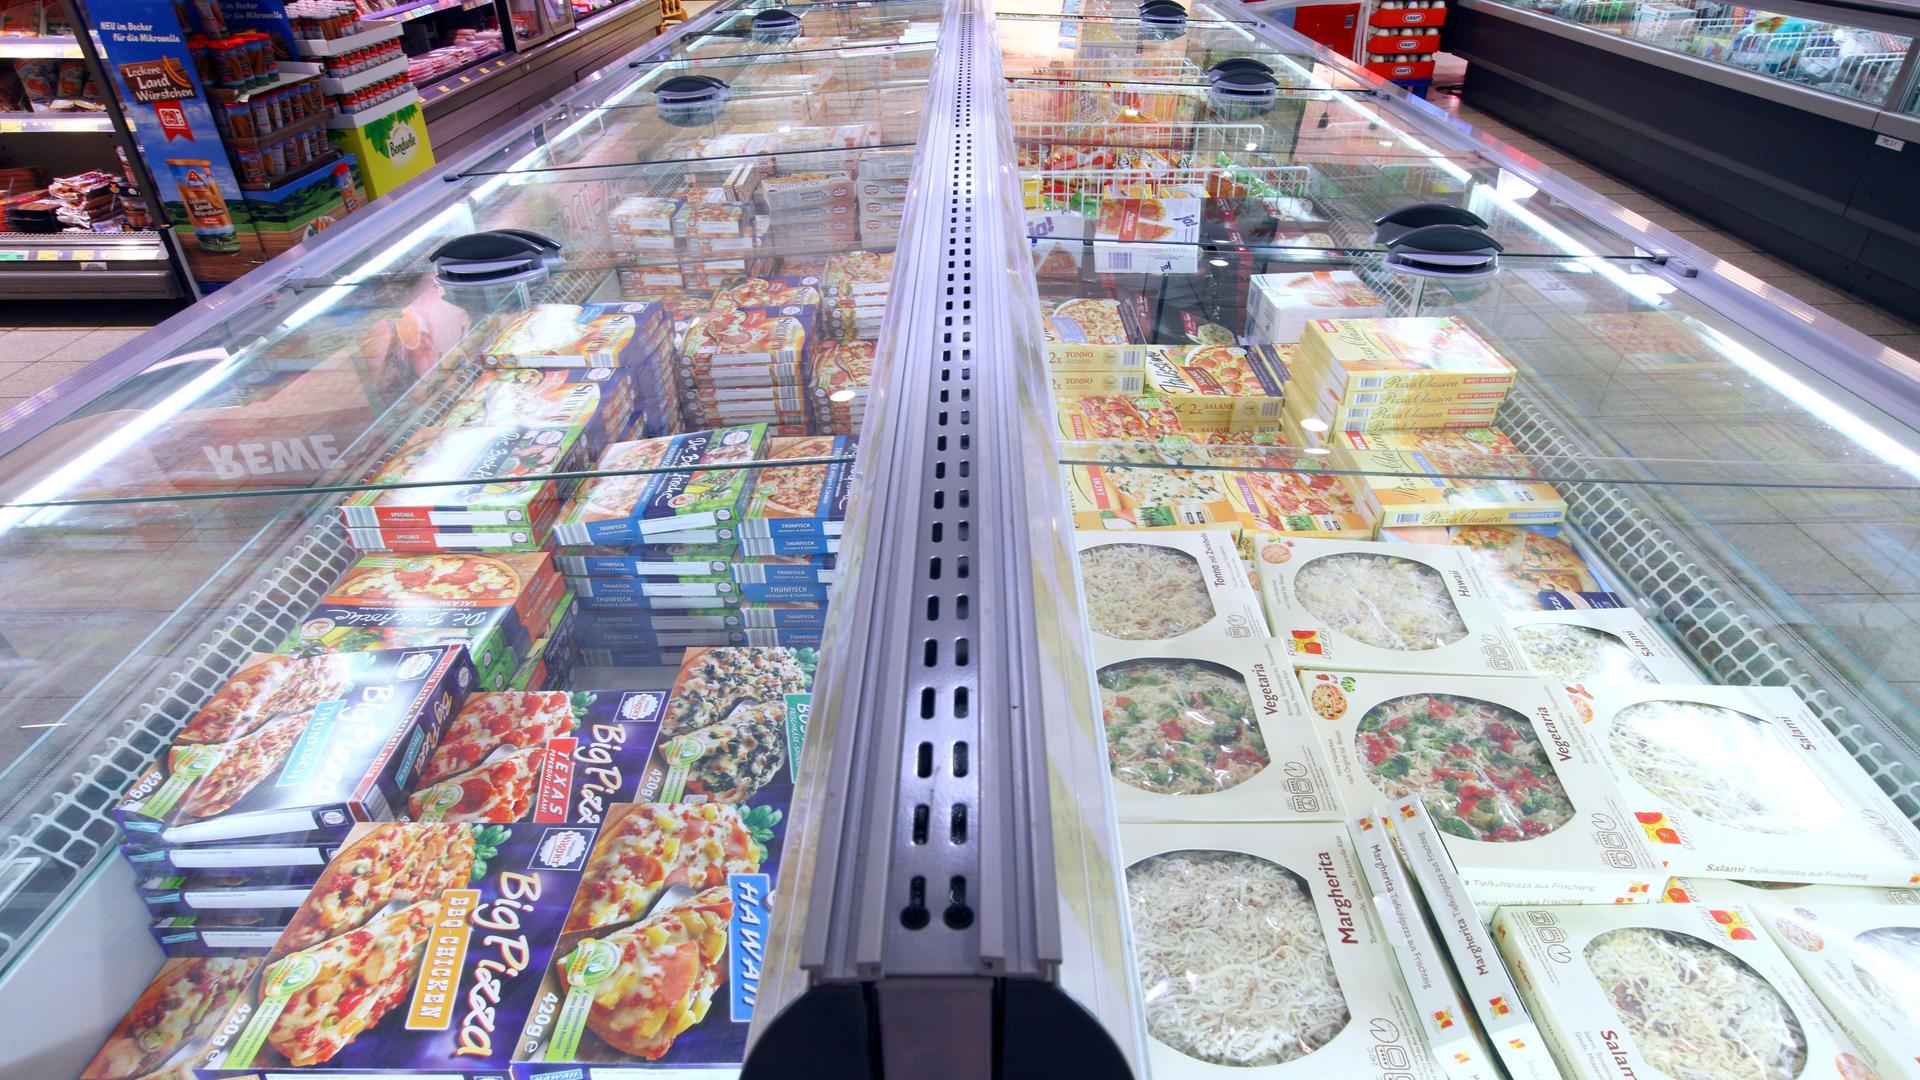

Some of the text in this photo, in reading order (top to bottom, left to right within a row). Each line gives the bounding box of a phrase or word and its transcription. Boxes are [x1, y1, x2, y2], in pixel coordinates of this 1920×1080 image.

[100, 22, 153, 31] NEU im Becher
[112, 34, 181, 43] für die Mikrowelle
[126, 66, 162, 78] Leckere
[137, 75, 171, 89] Land
[136, 89, 194, 102] Würstchen
[389, 134, 416, 157] Bonduelle
[1027, 217, 1055, 239] ja!
[1173, 214, 1198, 228] ja!
[1048, 351, 1094, 364] 2x TONNO
[1065, 377, 1094, 385] TONNO
[1384, 375, 1418, 390] Pizza
[1419, 375, 1458, 389] Classica
[1189, 402, 1202, 415] 2x
[1380, 391, 1411, 406] Pizza
[1371, 405, 1402, 420] Pizza
[688, 437, 707, 453] Die
[599, 524, 627, 532] THUNFISCH
[1422, 510, 1458, 525] Pizza
[1459, 510, 1504, 523] Classica
[1211, 565, 1226, 588] Tonno
[1447, 569, 1472, 598] Hawaii
[459, 611, 488, 626] Die
[1623, 630, 1654, 658] Salami
[1252, 663, 1278, 716] Vegetaria
[434, 691, 453, 725] Big
[1537, 706, 1573, 762] Vegetaria
[1775, 715, 1818, 752] Salami
[130, 771, 163, 800] 420g
[549, 751, 570, 816] TEXAS
[574, 724, 627, 824] Big Pizz
[640, 768, 662, 797] 420g
[553, 832, 574, 867] Wagner
[1706, 864, 1747, 873] Salami
[1320, 851, 1359, 945] Margherita
[1552, 883, 1596, 892] Frischteig
[1371, 844, 1394, 894] Margherita
[1406, 938, 1416, 952] aus
[1414, 952, 1433, 990] Frischteig
[739, 882, 763, 1006] HAWAII
[1457, 918, 1489, 976] Margherita
[419, 897, 470, 1019] BBQ-CHICKEN
[455, 871, 542, 1058] Big Pizza
[212, 1004, 252, 1047] 420g
[525, 992, 559, 1039] 420g
[1600, 1030, 1638, 1080] Salam
